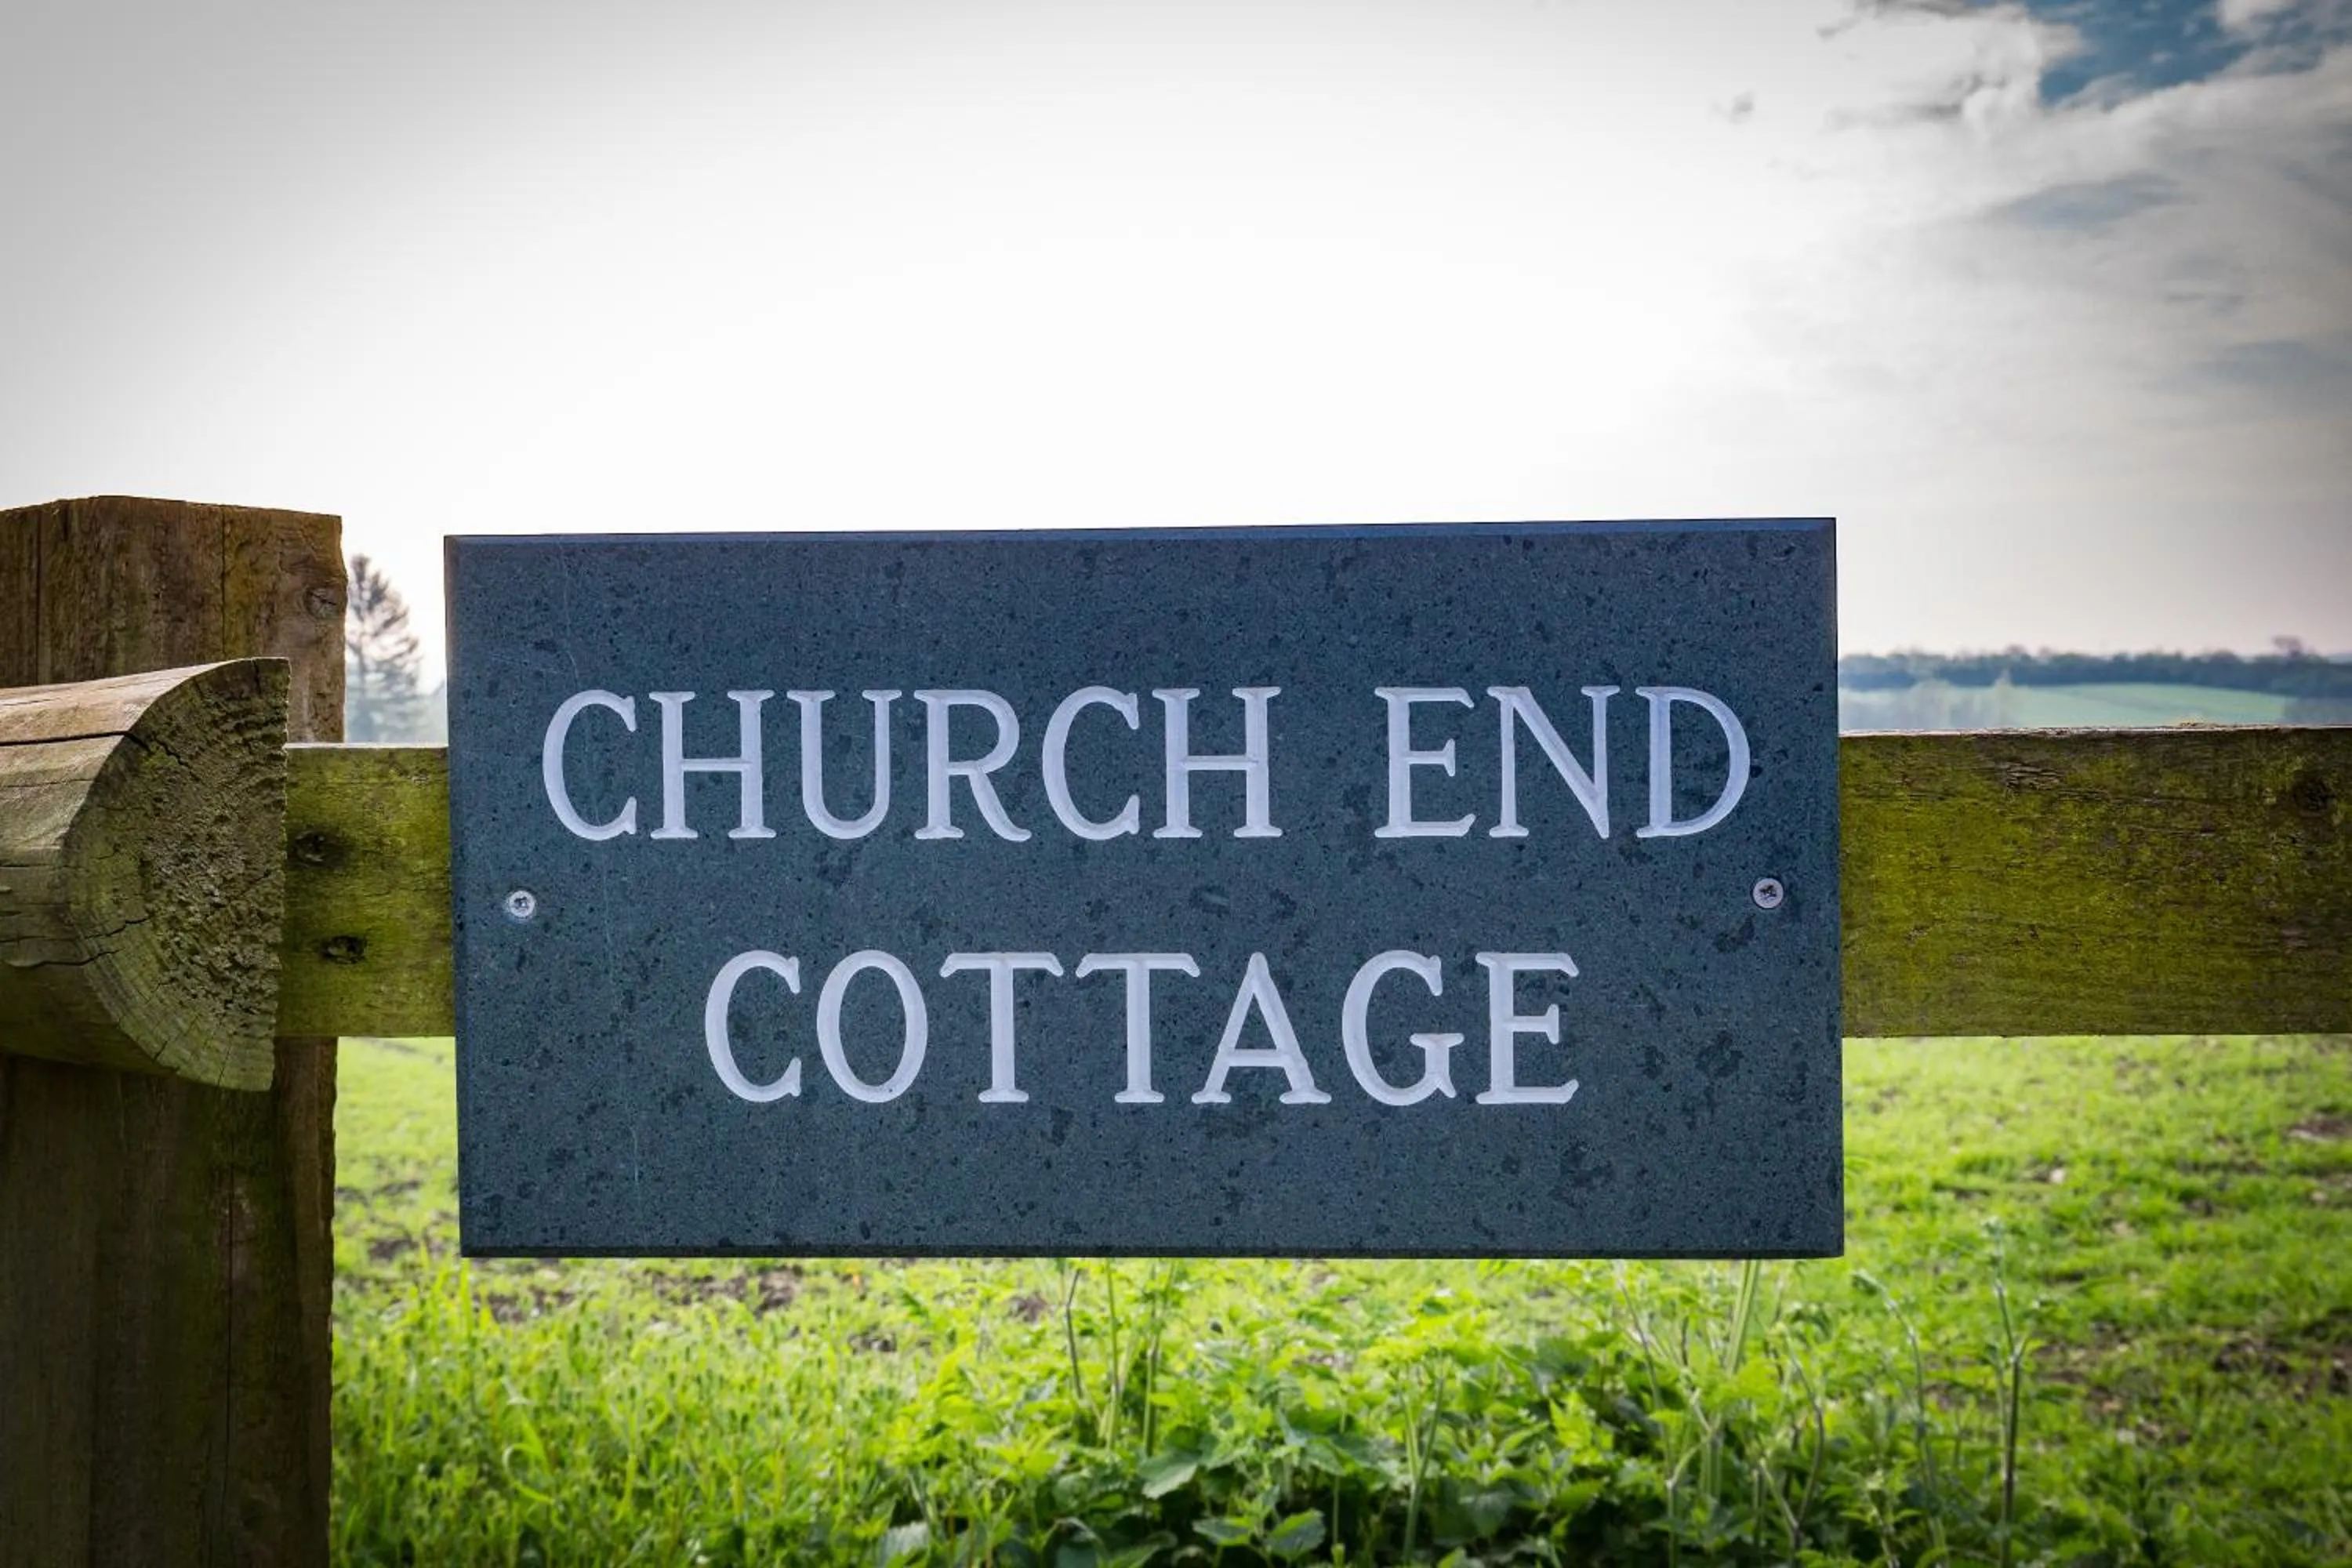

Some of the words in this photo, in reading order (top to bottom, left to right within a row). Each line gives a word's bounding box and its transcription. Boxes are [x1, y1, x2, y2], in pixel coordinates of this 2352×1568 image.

[541, 685, 1283, 842] CHURCH
[1373, 684, 1752, 840] END
[704, 949, 1581, 1107] COTTAGE
